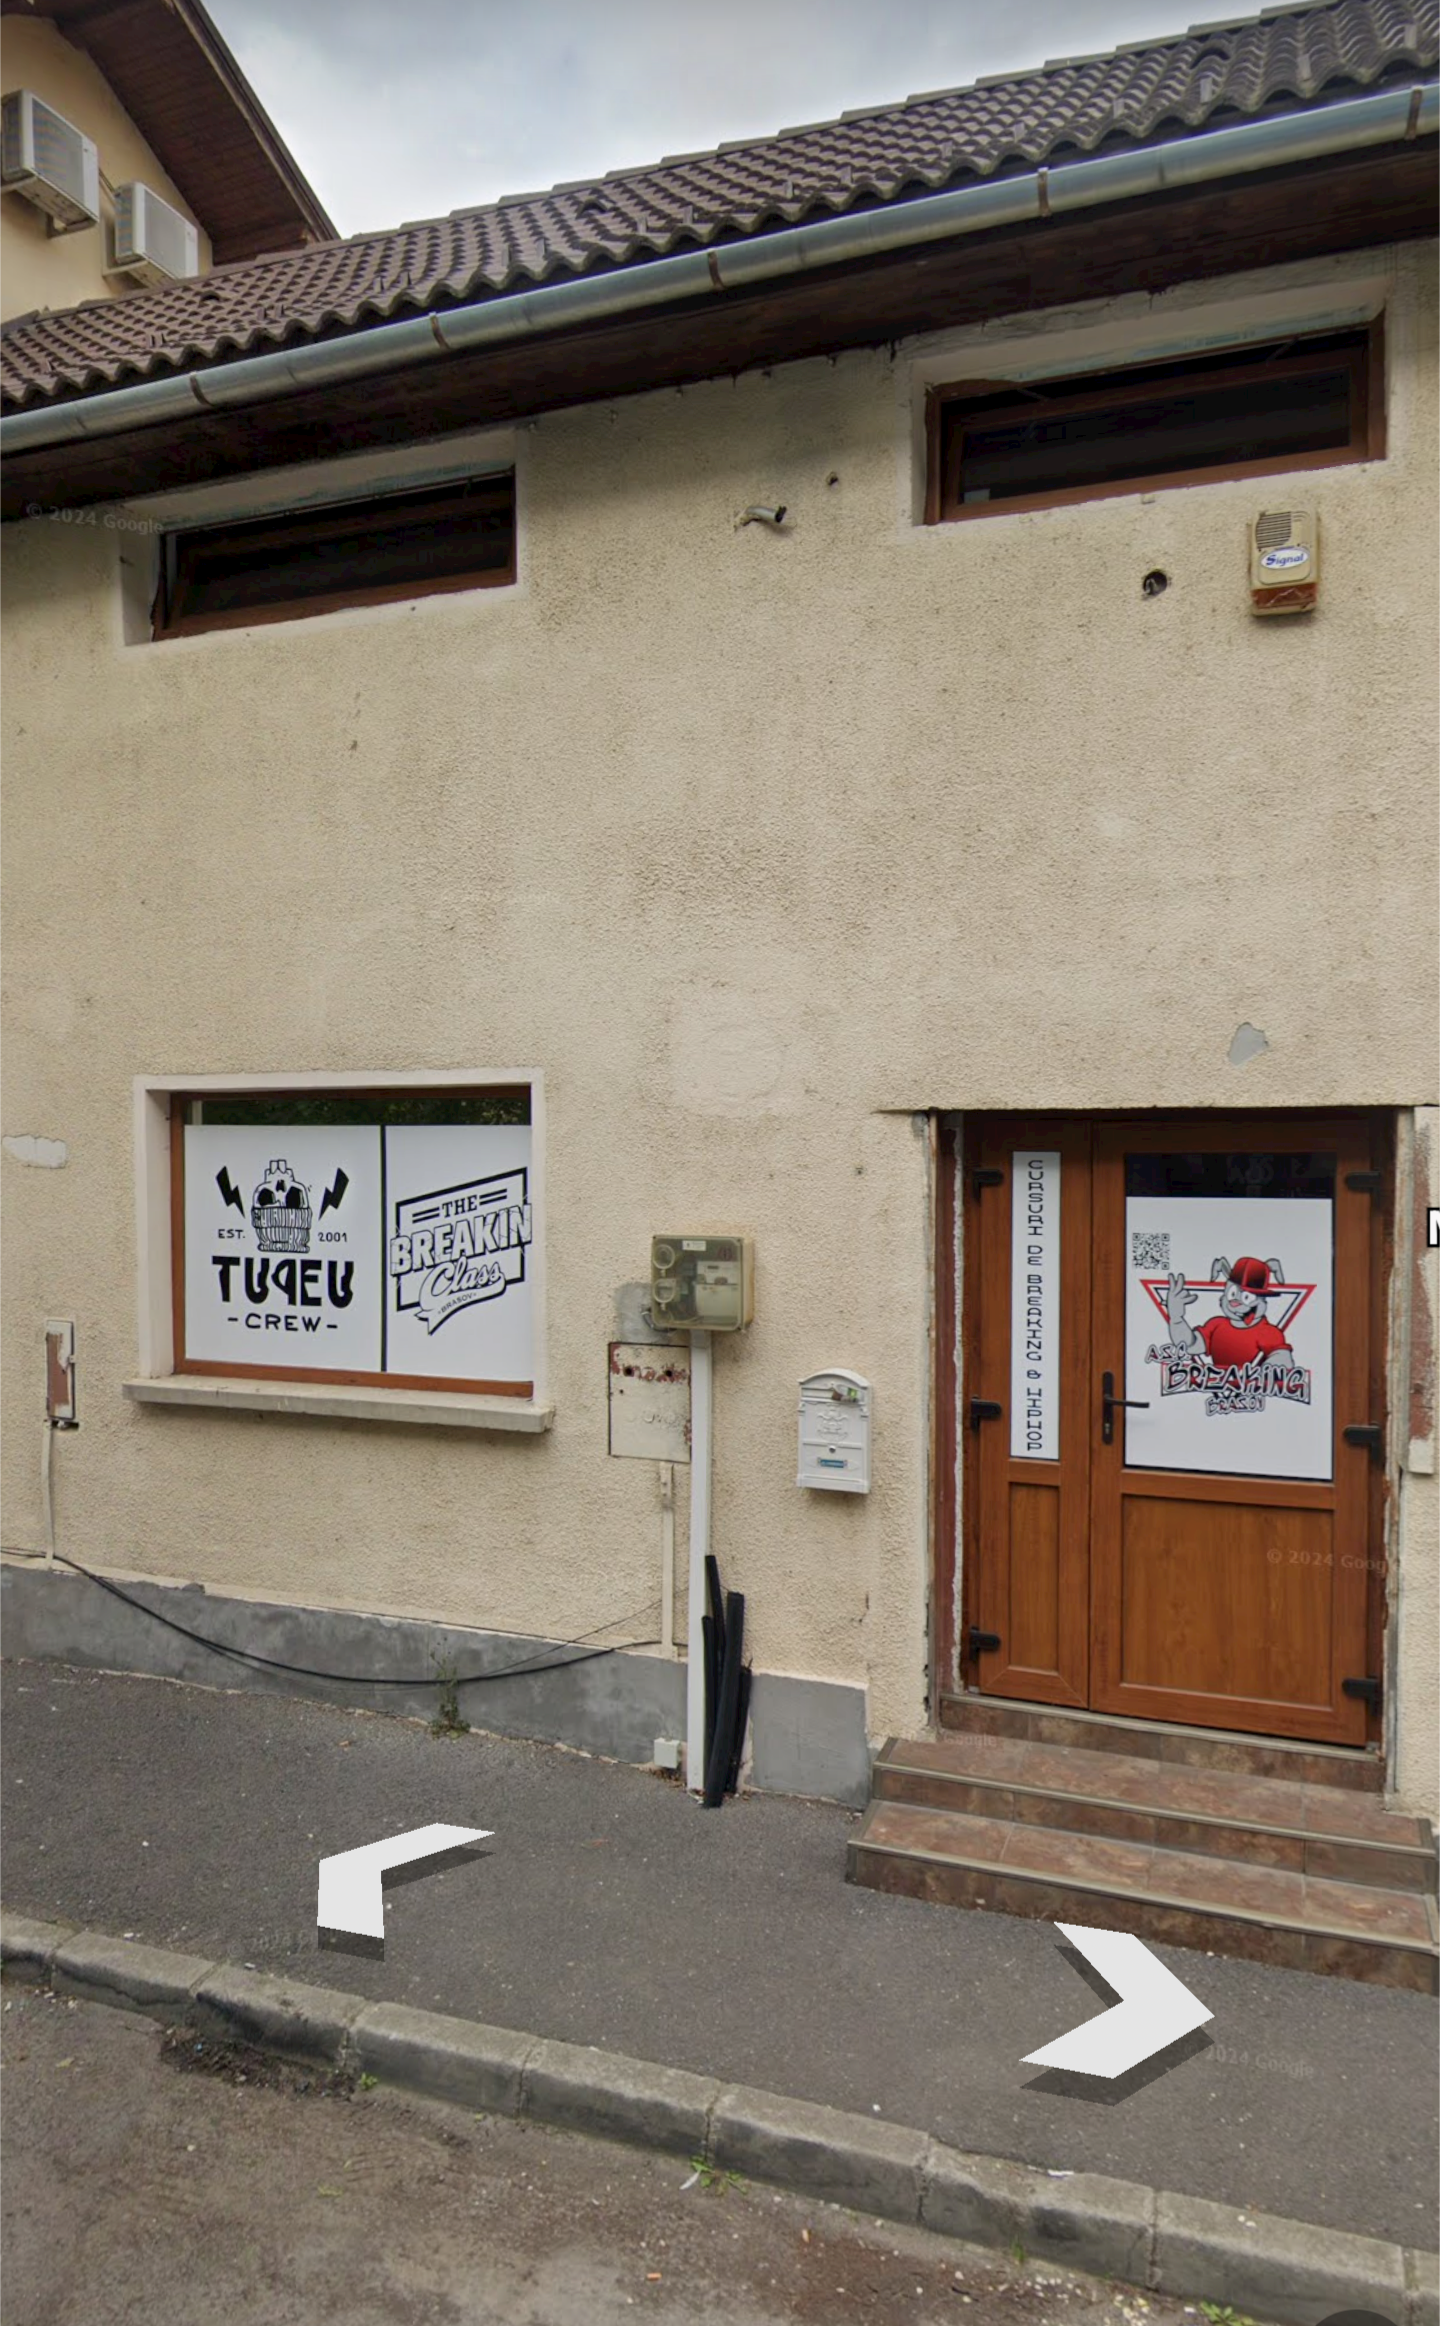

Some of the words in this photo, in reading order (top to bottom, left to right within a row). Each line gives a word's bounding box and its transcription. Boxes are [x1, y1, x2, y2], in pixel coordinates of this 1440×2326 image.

[1266, 553, 1304, 567] Signal
[442, 1194, 478, 1218] THE
[1027, 1159, 1044, 1236] CURSURI
[218, 1228, 246, 1240] EST.
[317, 1231, 348, 1243] 2001
[390, 1203, 532, 1278] BREAKIN
[1027, 1244, 1043, 1266] DE
[419, 1254, 504, 1298] Class
[440, 1291, 473, 1314] BRASOV
[1026, 1274, 1043, 1361] BREAKING
[1026, 1387, 1043, 1452] HIPHOP
